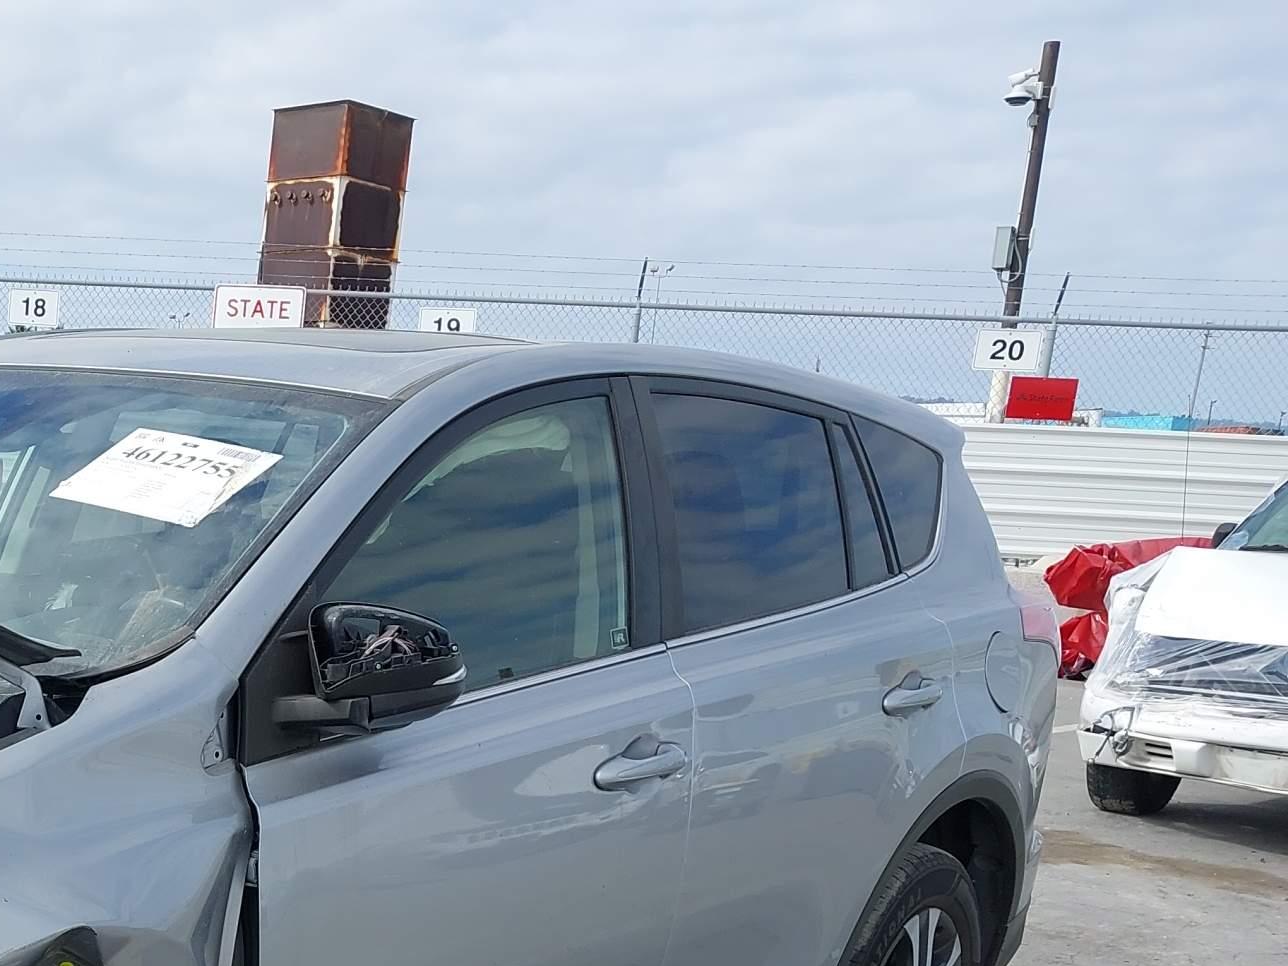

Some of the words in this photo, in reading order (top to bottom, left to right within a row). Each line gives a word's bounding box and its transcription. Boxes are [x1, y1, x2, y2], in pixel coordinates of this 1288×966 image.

[23, 298, 45, 317] 18
[227, 299, 290, 319] STATE
[990, 340, 1024, 360] 20
[122, 446, 242, 478] 46122755
